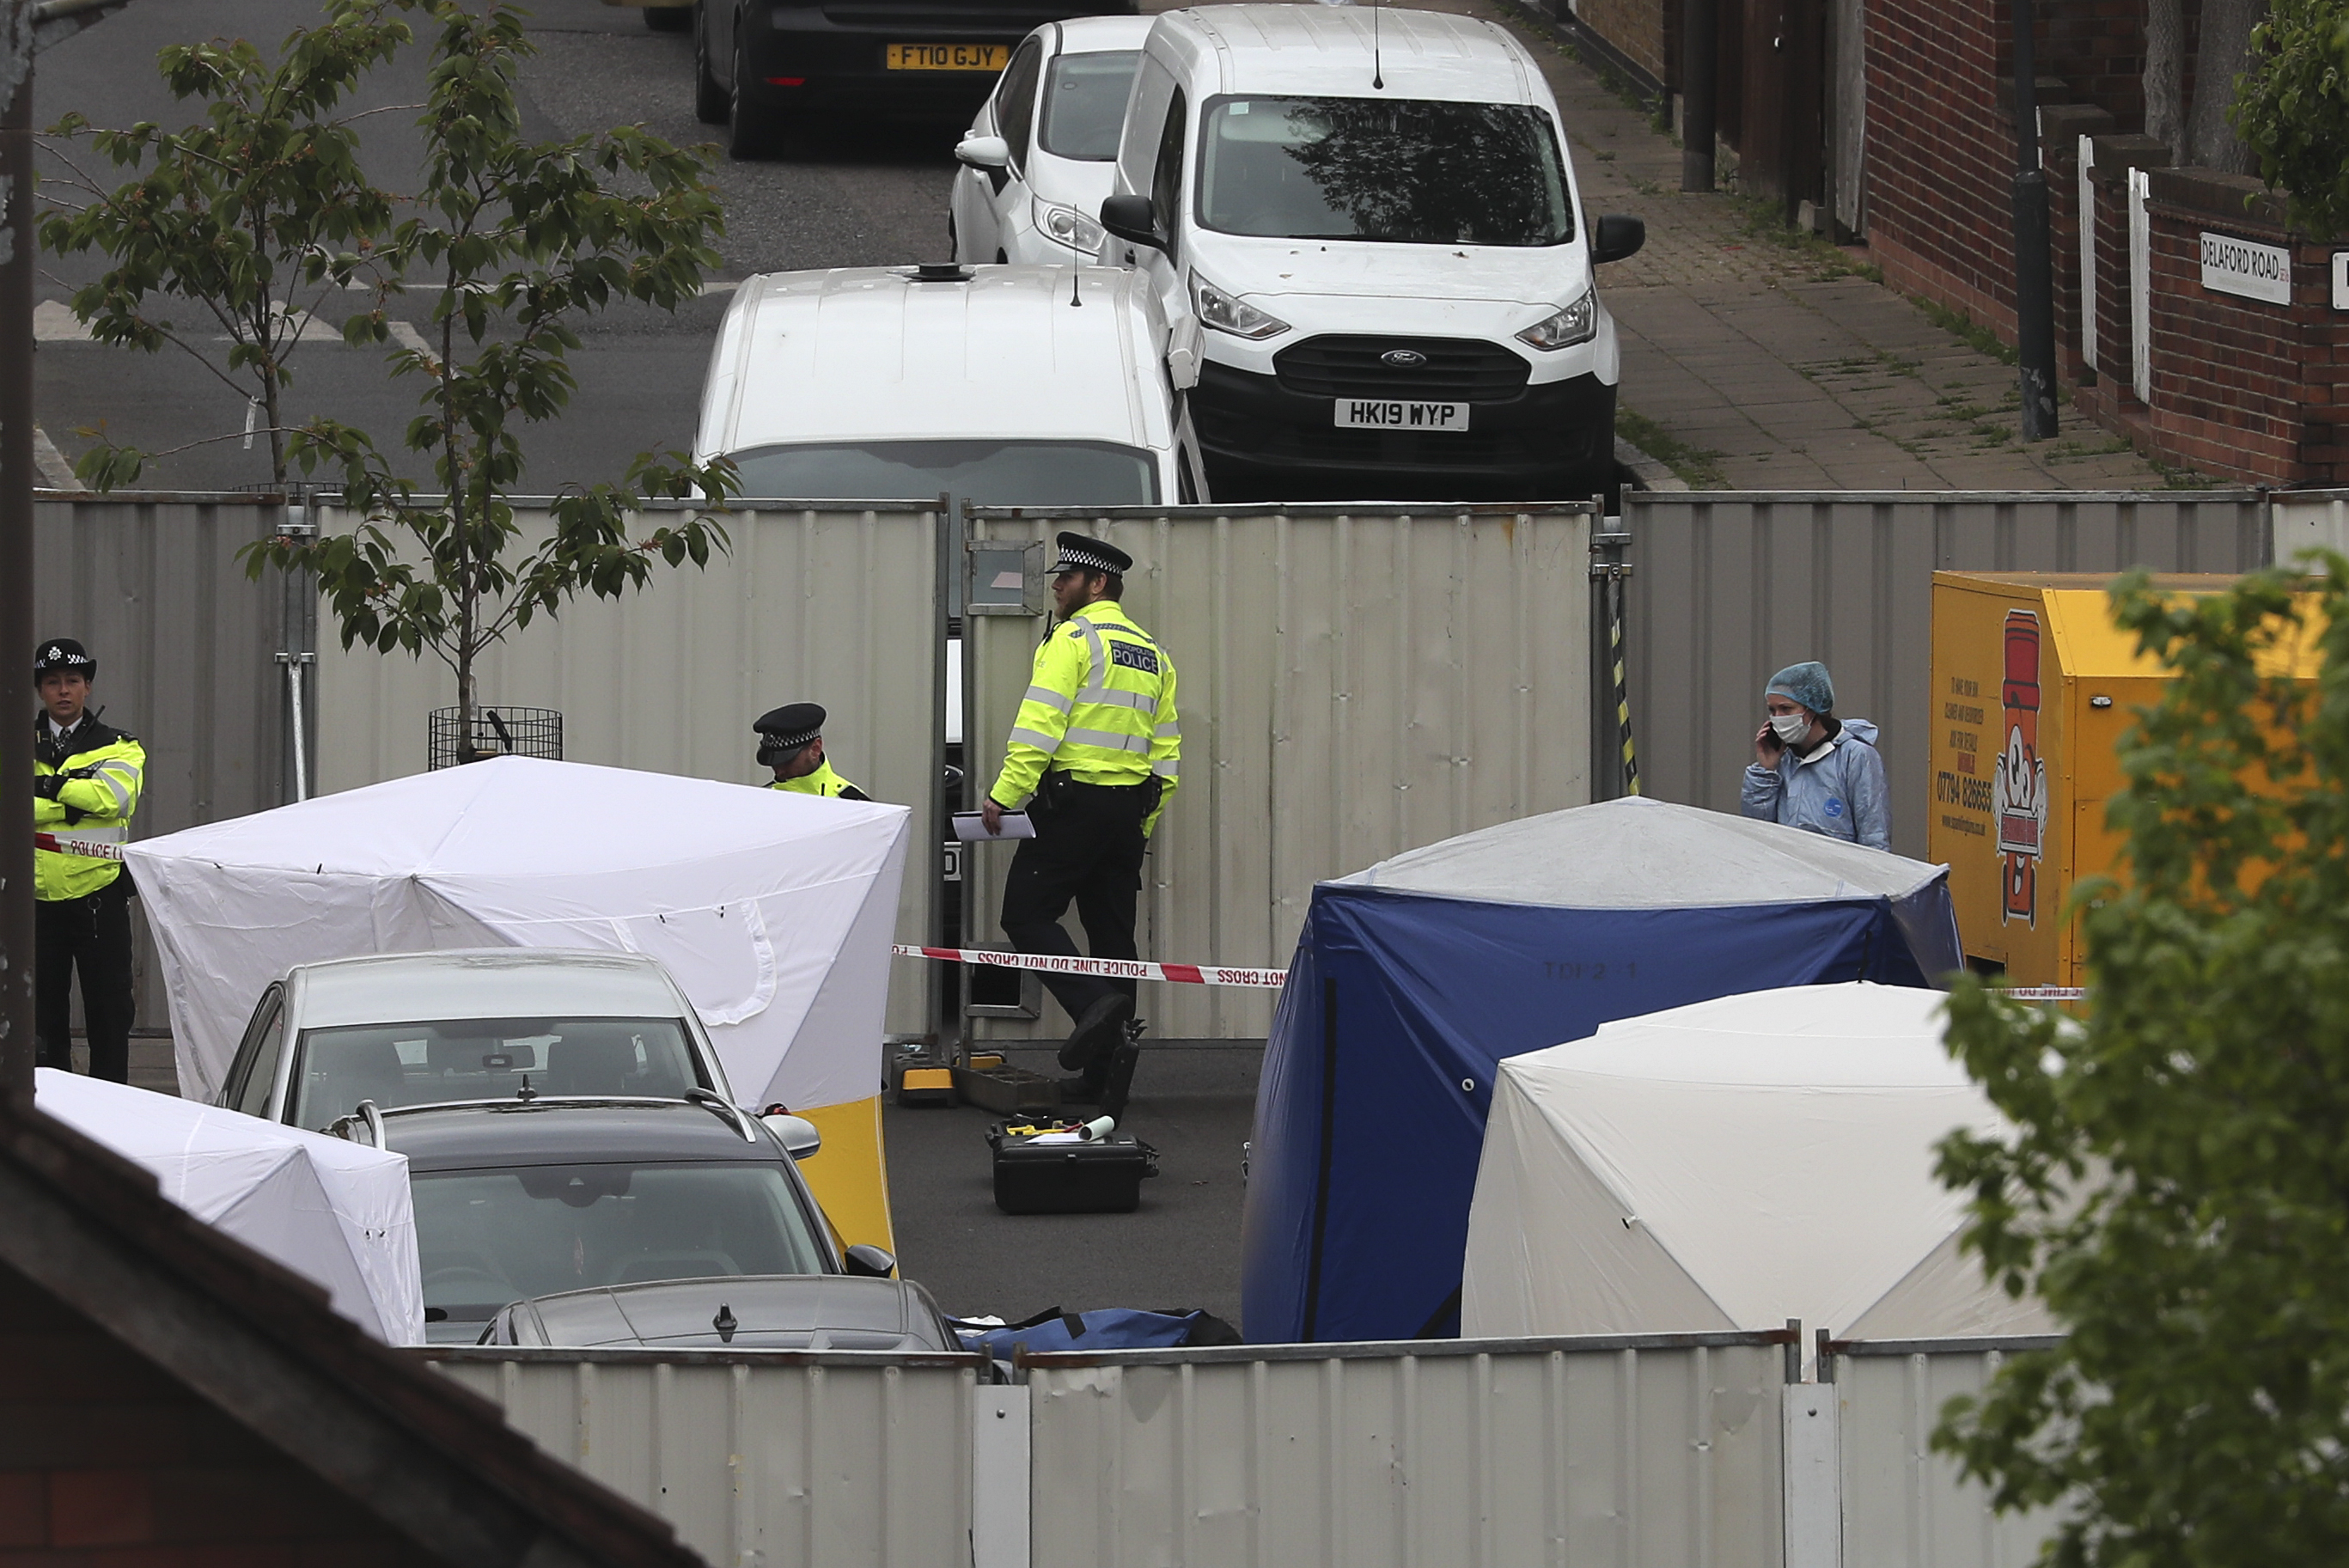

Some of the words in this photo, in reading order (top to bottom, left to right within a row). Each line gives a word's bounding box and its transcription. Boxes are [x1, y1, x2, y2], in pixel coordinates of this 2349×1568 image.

[902, 46, 948, 65] FT10
[955, 46, 994, 66] GJY
[2202, 240, 2249, 274] DELAFORD
[2252, 249, 2279, 280] ROAD
[1391, 352, 1417, 363] Ford
[1351, 402, 1402, 424] HK19
[1410, 404, 1455, 426] WYP
[1113, 649, 1157, 674] POLICE
[1937, 771, 1960, 804] 07794
[70, 839, 111, 859] POLICE
[978, 952, 1019, 966] CROSS
[1025, 956, 1048, 968] NOT
[1051, 958, 1069, 971] DO
[1073, 959, 1100, 973] LINE
[1103, 961, 1148, 977] POLICE
[1217, 969, 1259, 985] CROSS
